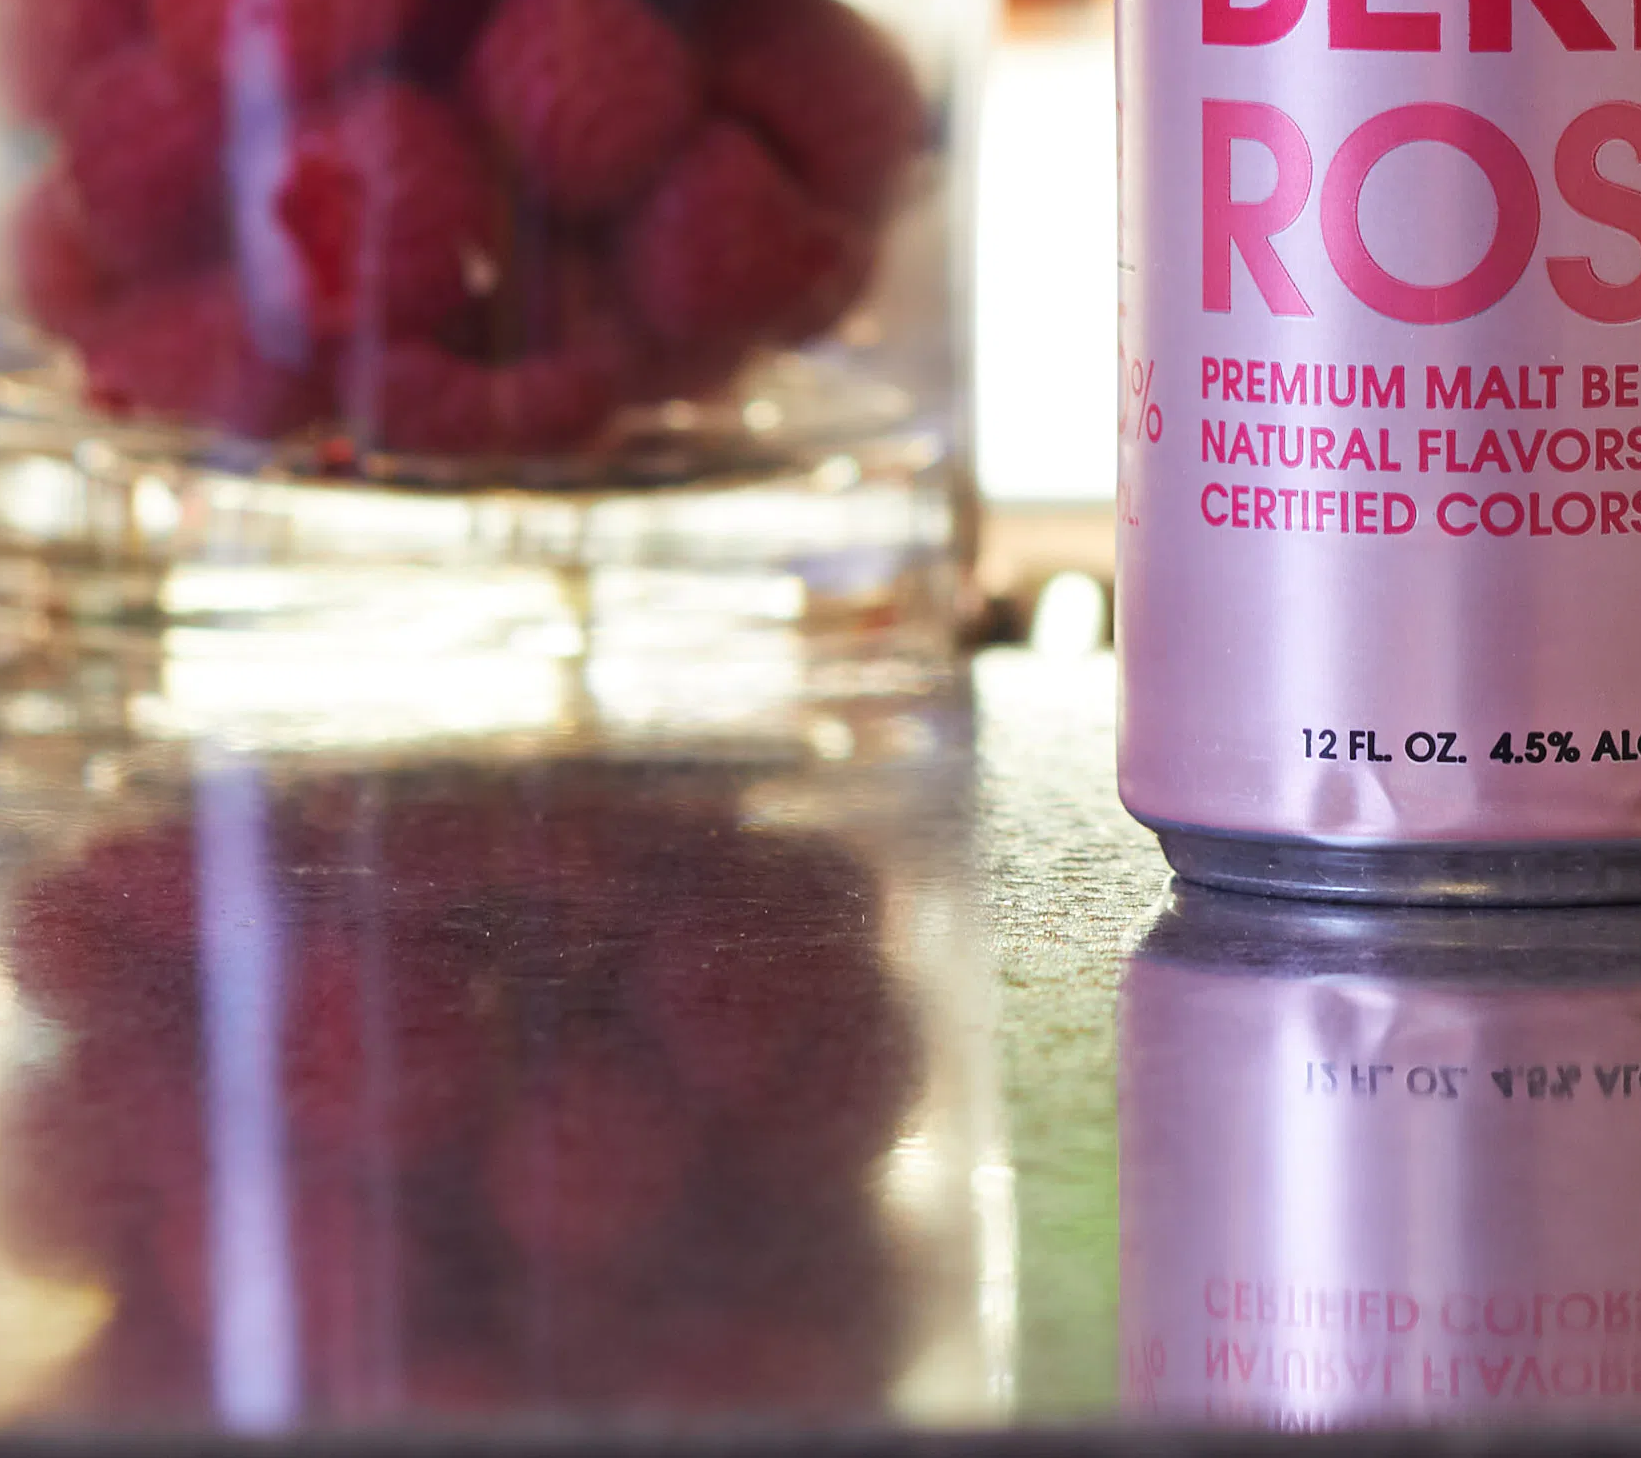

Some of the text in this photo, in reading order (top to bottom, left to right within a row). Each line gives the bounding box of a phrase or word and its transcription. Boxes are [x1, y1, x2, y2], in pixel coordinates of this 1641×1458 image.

[1200, 355, 1407, 410] PREMIUM
[1425, 364, 1565, 411] MALT
[1200, 419, 1401, 473] NATURAL
[1200, 481, 1418, 536] CERTIFIED
[1300, 728, 1339, 762] 12
[1348, 729, 1393, 764] FL.
[1403, 730, 1468, 766] OZ.
[1489, 732, 1581, 766] 4.5%
